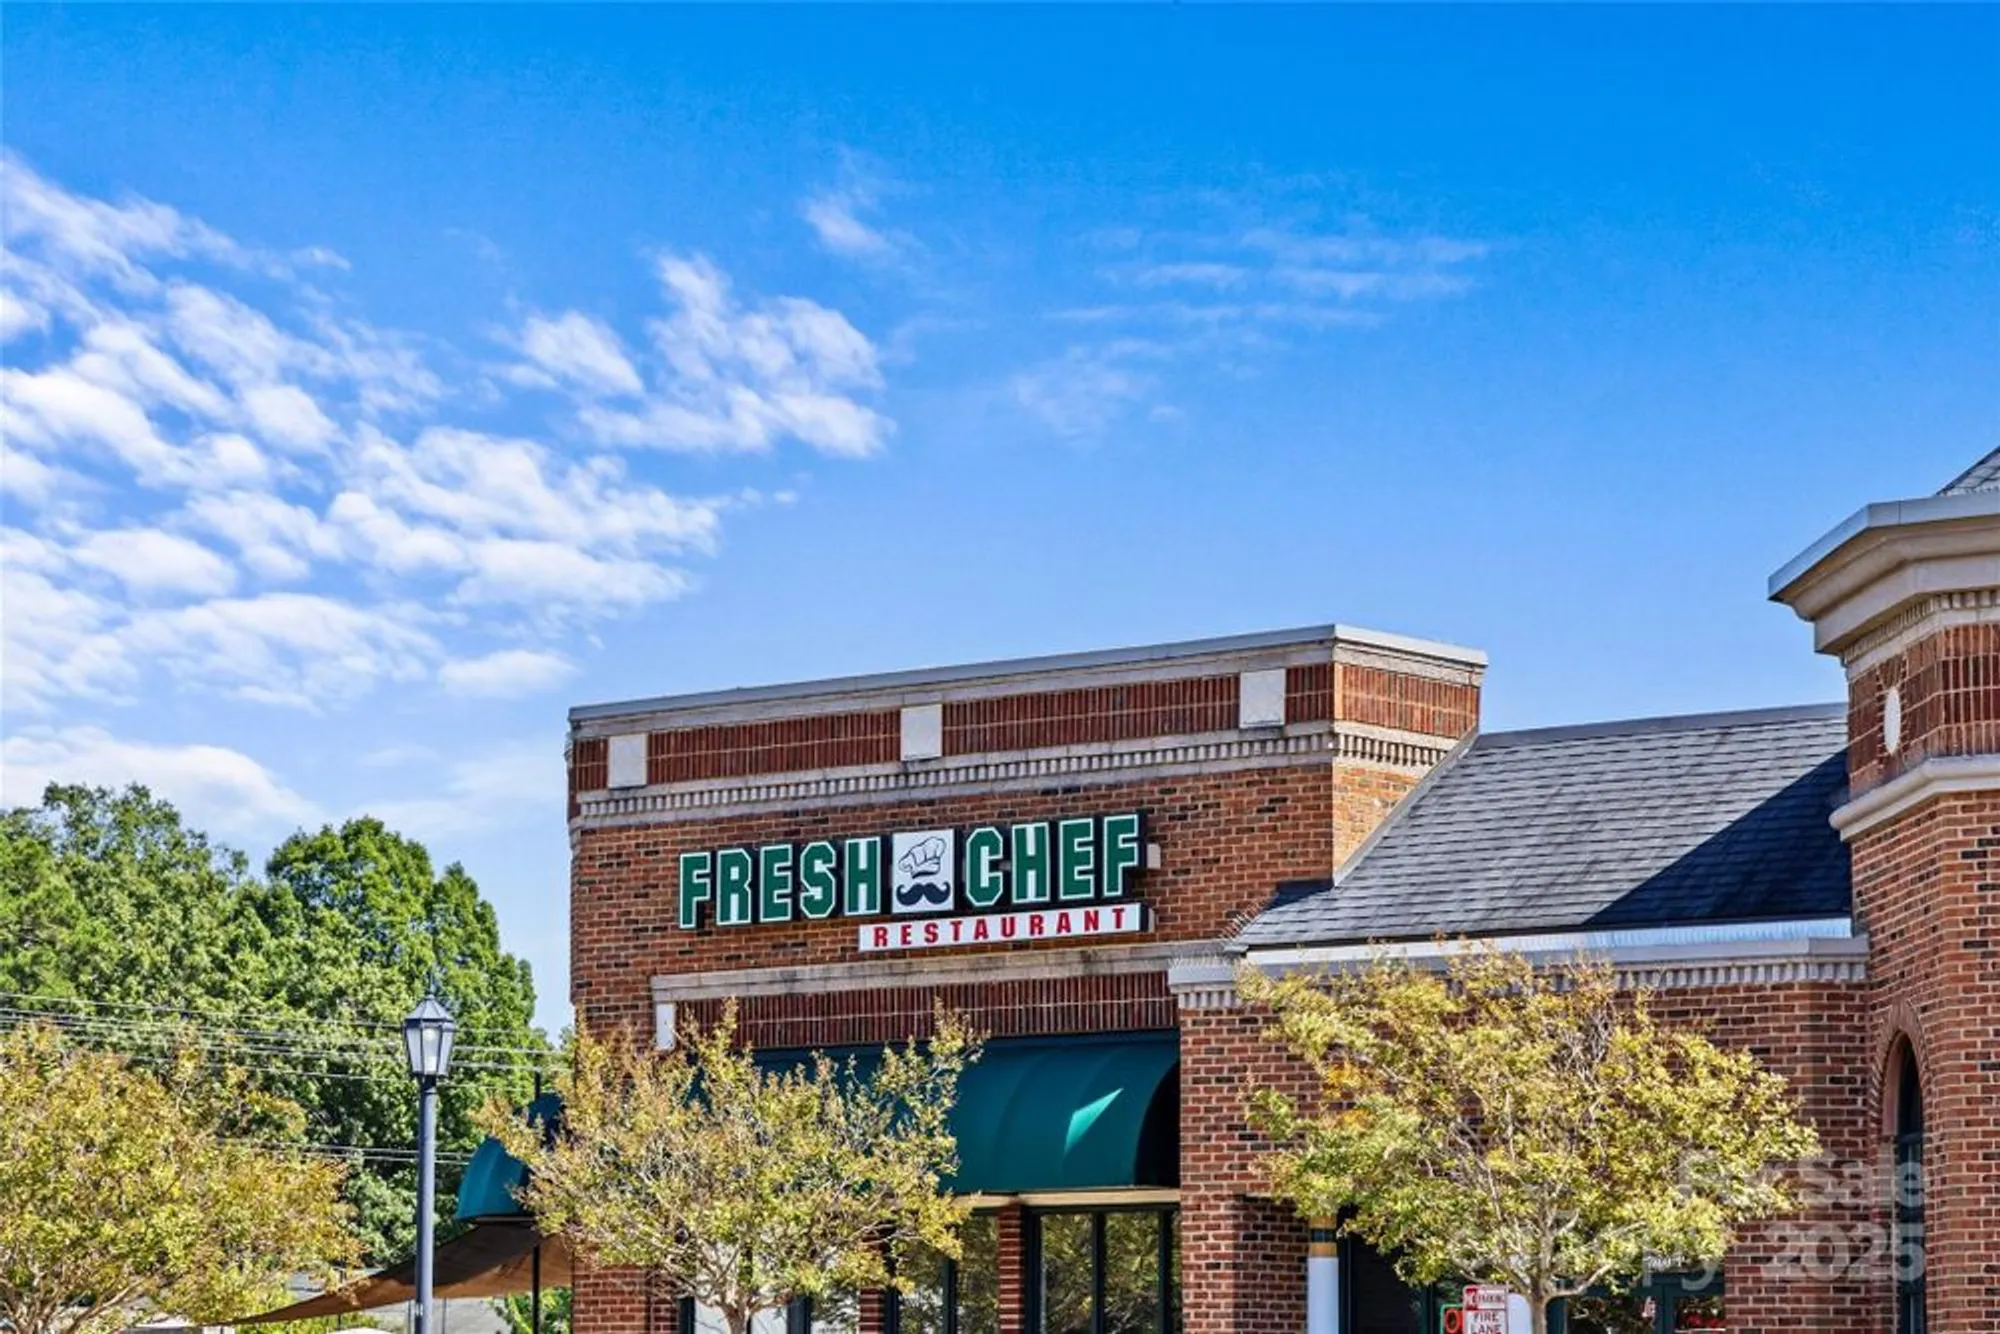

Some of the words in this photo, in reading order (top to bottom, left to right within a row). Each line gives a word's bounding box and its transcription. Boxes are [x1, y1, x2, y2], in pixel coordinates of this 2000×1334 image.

[680, 836, 881, 929] FRESH
[965, 814, 1139, 907] CHEF
[873, 908, 1125, 947] RESTAURANT
[1470, 1323, 1502, 1334] LANE
[1473, 1311, 1500, 1321] FIRE
